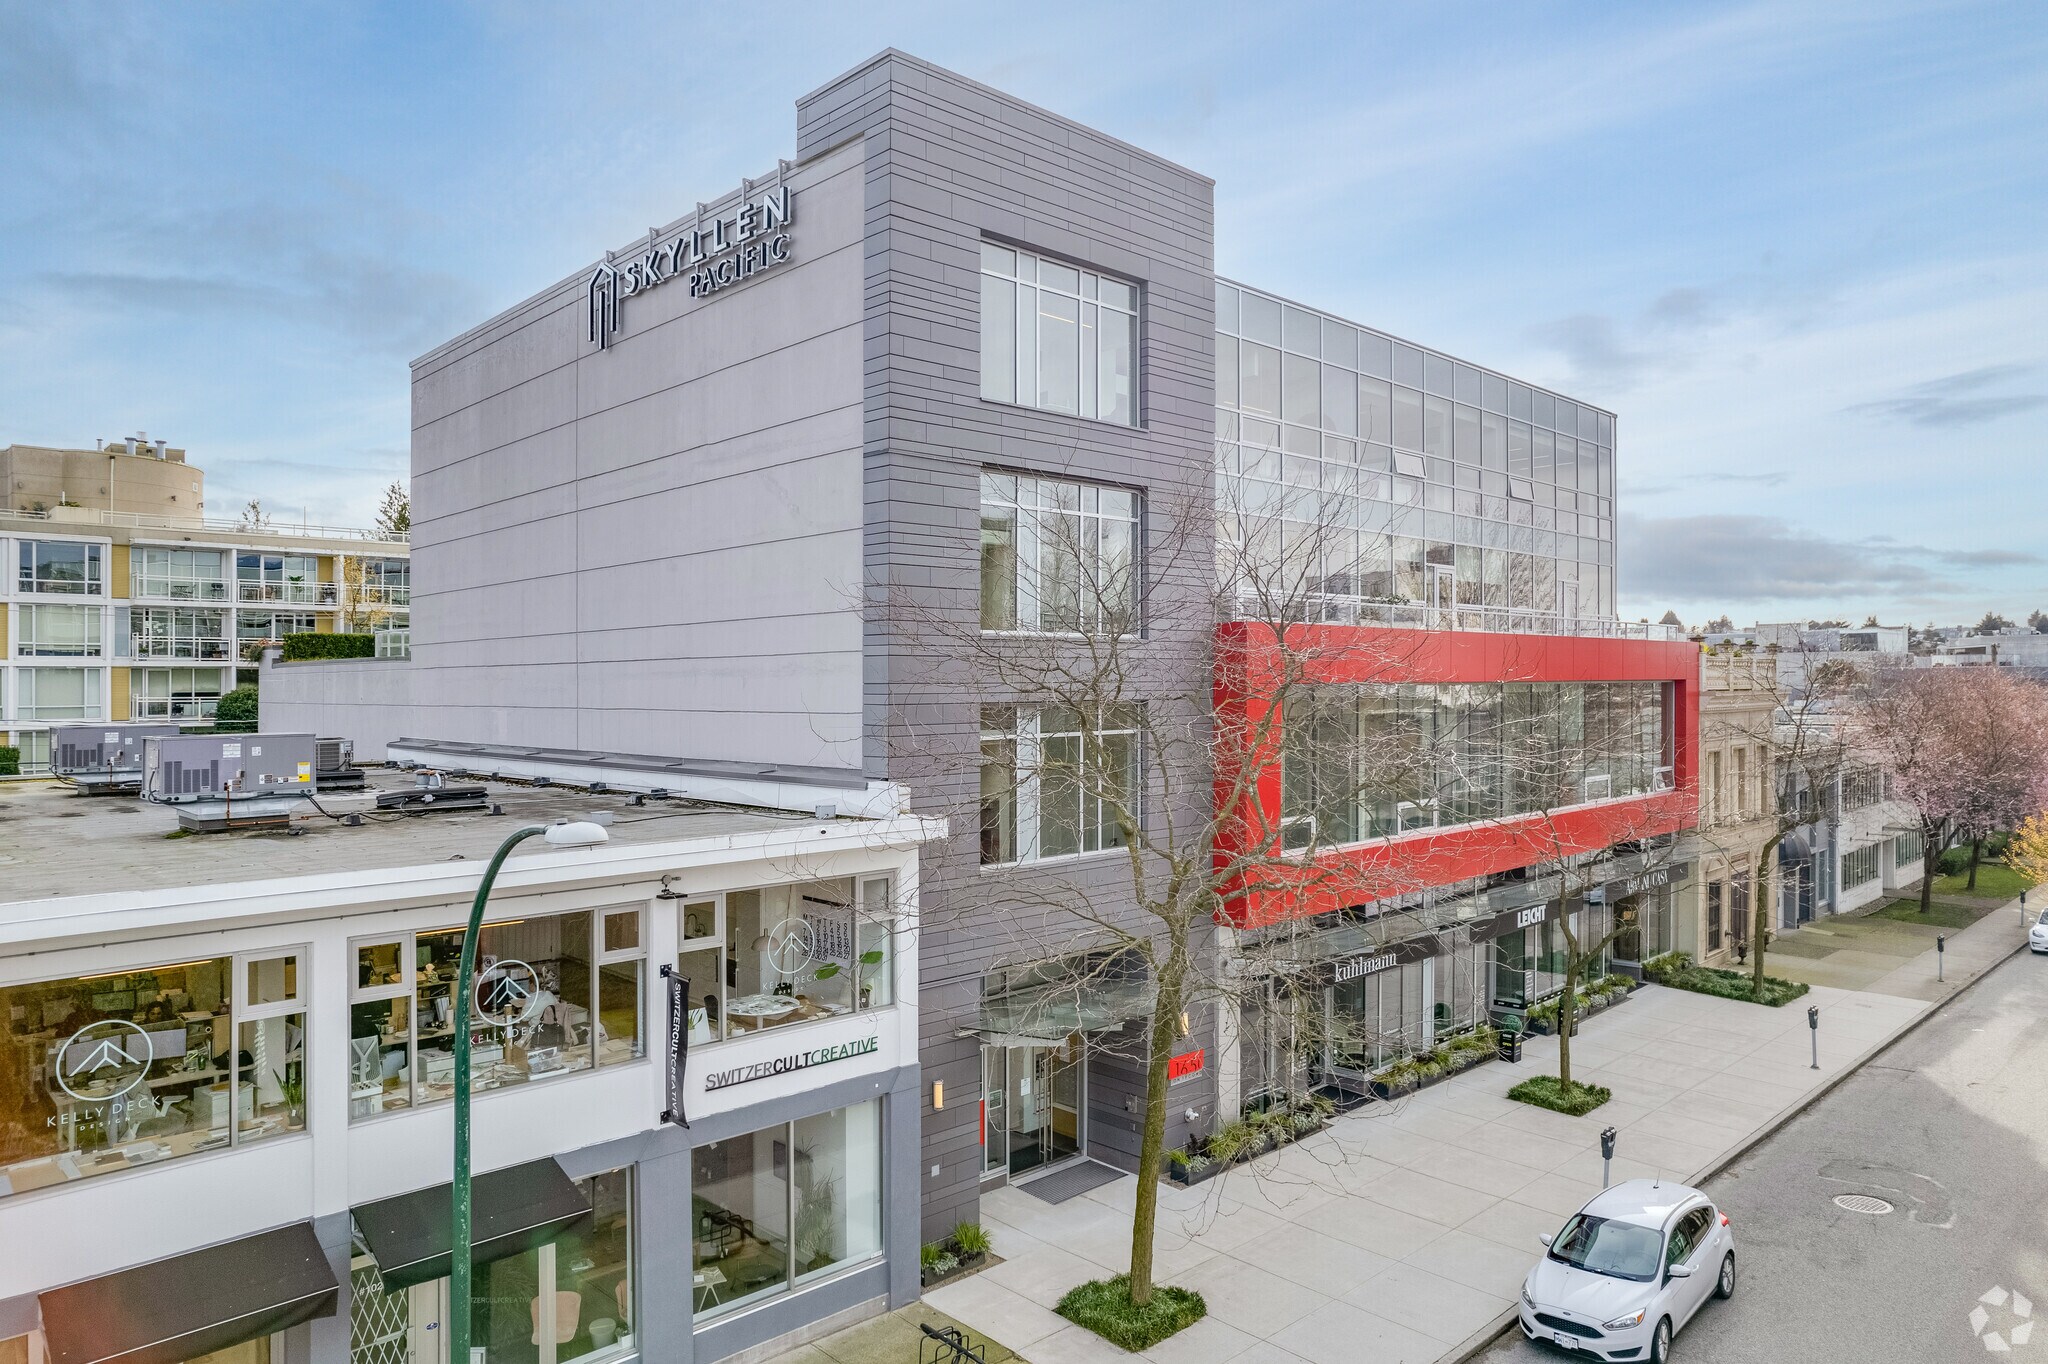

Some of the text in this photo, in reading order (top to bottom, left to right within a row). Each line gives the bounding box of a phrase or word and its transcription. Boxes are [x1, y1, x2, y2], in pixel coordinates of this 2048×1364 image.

[624, 186, 792, 295] SKYLLEN
[689, 233, 792, 298] PACIFIC
[1517, 904, 1546, 928] LEICHT
[763, 973, 818, 990] KELLY DECK
[1334, 953, 1397, 982] kuhlmann
[470, 1030, 507, 1045] KELLY
[512, 1023, 544, 1038] DECK
[670, 982, 682, 1117] SWITZERCULTCREATIVE
[705, 1036, 878, 1089] SWITZERCULTCREATIVE
[47, 1095, 161, 1127] KELLY DECK
[79, 1116, 131, 1132] DESIGN
[359, 1282, 383, 1296] #102
